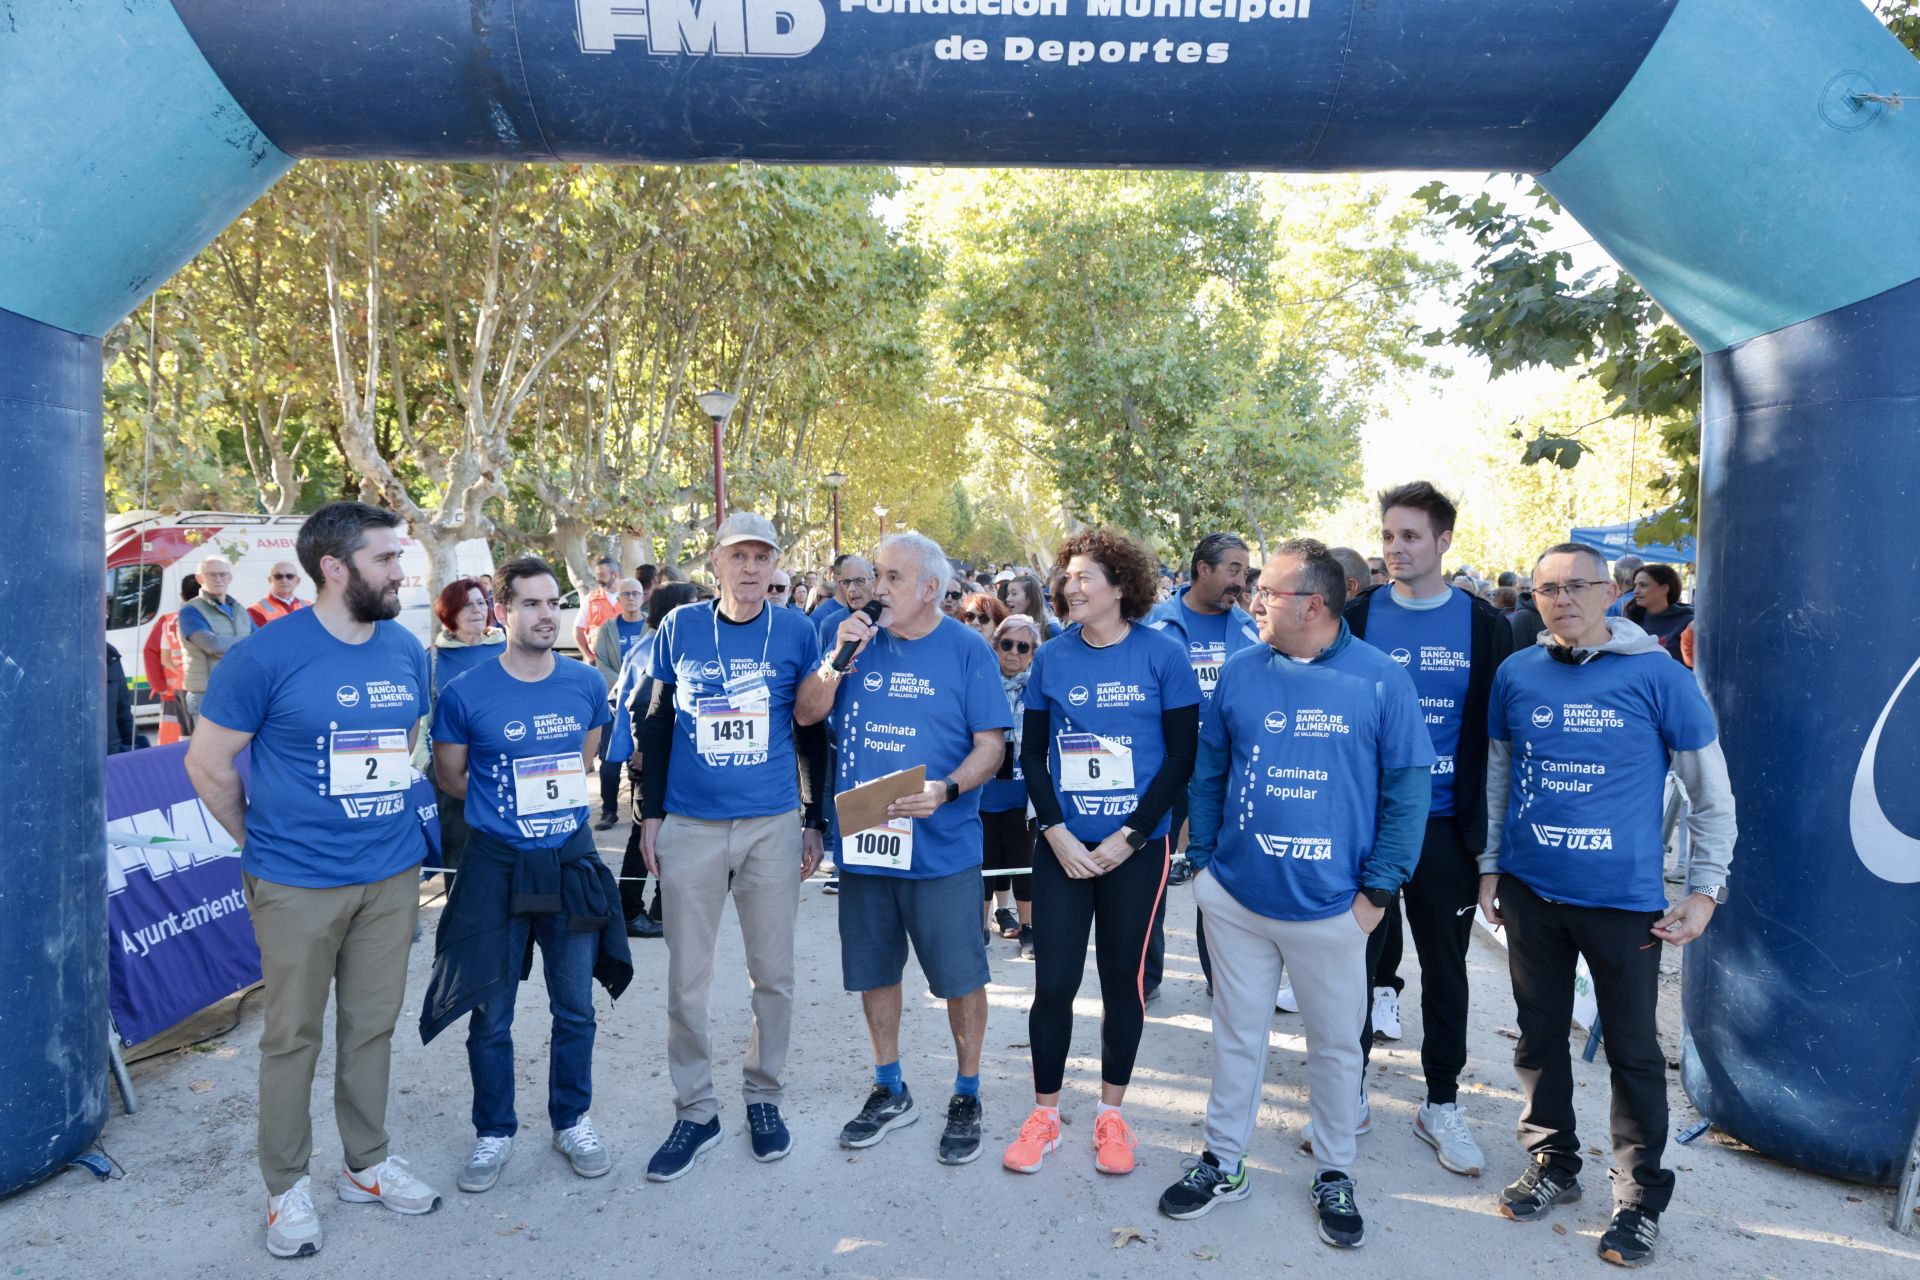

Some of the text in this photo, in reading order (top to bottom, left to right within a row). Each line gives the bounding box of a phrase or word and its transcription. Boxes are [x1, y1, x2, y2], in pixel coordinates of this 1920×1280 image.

[1086, 0, 1310, 22] Municipal
[575, 0, 827, 58] FMD
[934, 35, 1230, 66] de Deportes
[1420, 650, 1464, 660] BANCO DE
[730, 662, 771, 670] BANCO DE
[1420, 658, 1471, 668] ALIMENTOS
[730, 670, 777, 678] ALIMTOS
[890, 677, 930, 687] BANCO DE
[367, 685, 408, 694] BANCO DE
[889, 685, 935, 696] ALIMENTOS
[1096, 685, 1139, 694] BANCO DE
[370, 693, 414, 702] ALIMENTOS
[1096, 693, 1146, 702] ALIMENTOS
[1296, 714, 1344, 724] BANCO DE
[1564, 708, 1616, 718] BANCO DE
[534, 716, 576, 728] BANCO DE
[865, 721, 917, 736] Caminata
[1294, 722, 1350, 734] ALIMENTOS
[1564, 718, 1624, 728] ALIMENTOS
[536, 723, 582, 736] ALIMENTOS
[710, 720, 754, 741] 1431
[864, 738, 906, 752] Popular
[733, 752, 768, 766] ULSA
[365, 757, 378, 780] 2
[1088, 757, 1101, 780] 6
[1267, 766, 1328, 781] Caminata
[1541, 760, 1606, 775] Caminata
[546, 779, 559, 800] 5
[1266, 784, 1318, 800] Popular
[1541, 778, 1593, 793] Popular
[1103, 794, 1139, 802] COMERCIAL
[375, 798, 404, 816] ULSA
[1103, 801, 1139, 816] ULSA
[1566, 828, 1612, 836] COMERCIAL
[855, 833, 901, 857] 1000
[1292, 837, 1332, 845] COMERCIAL
[1566, 835, 1613, 850] ULSA
[1291, 844, 1332, 860] ULSA
